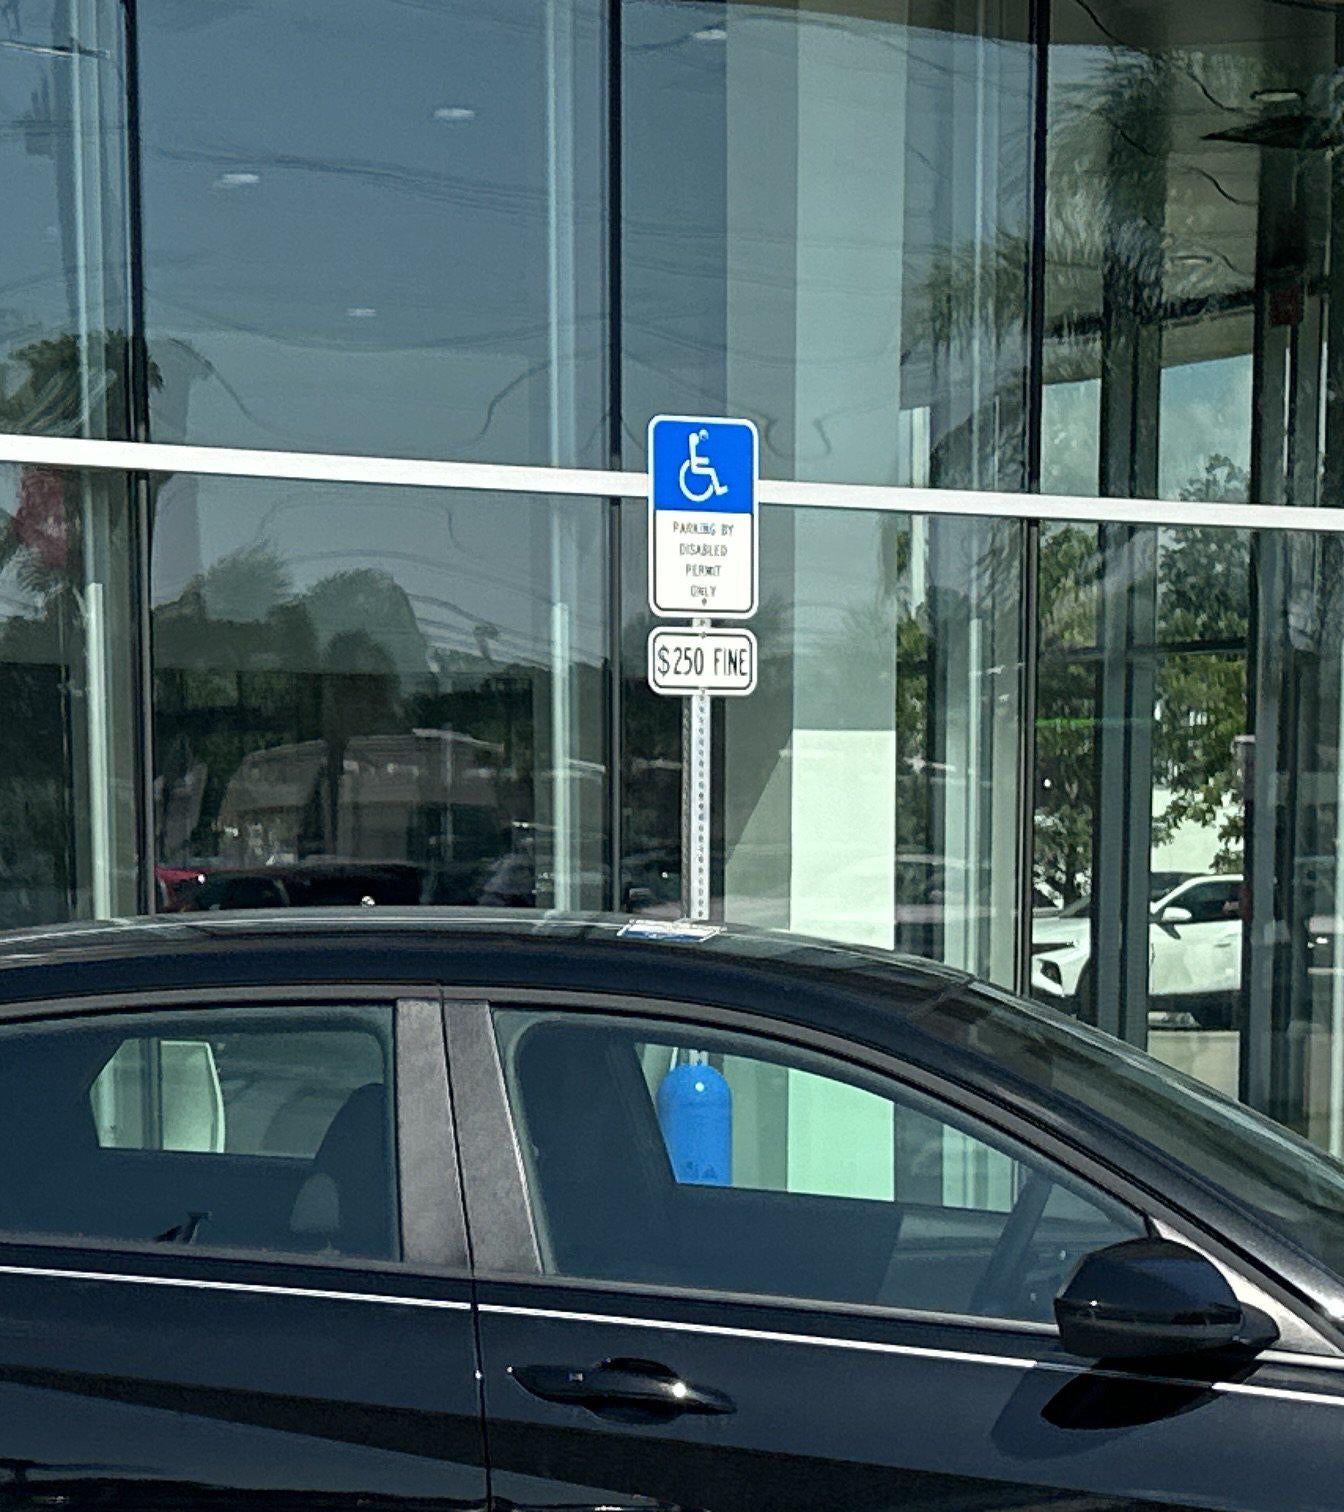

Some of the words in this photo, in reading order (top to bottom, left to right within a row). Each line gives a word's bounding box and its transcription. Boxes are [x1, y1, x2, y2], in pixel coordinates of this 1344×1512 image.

[720, 523, 735, 537] BY
[678, 542, 728, 557] DISABLED
[685, 562, 722, 577] PERMIT
[657, 645, 705, 677] $250
[713, 647, 748, 677] FINE
